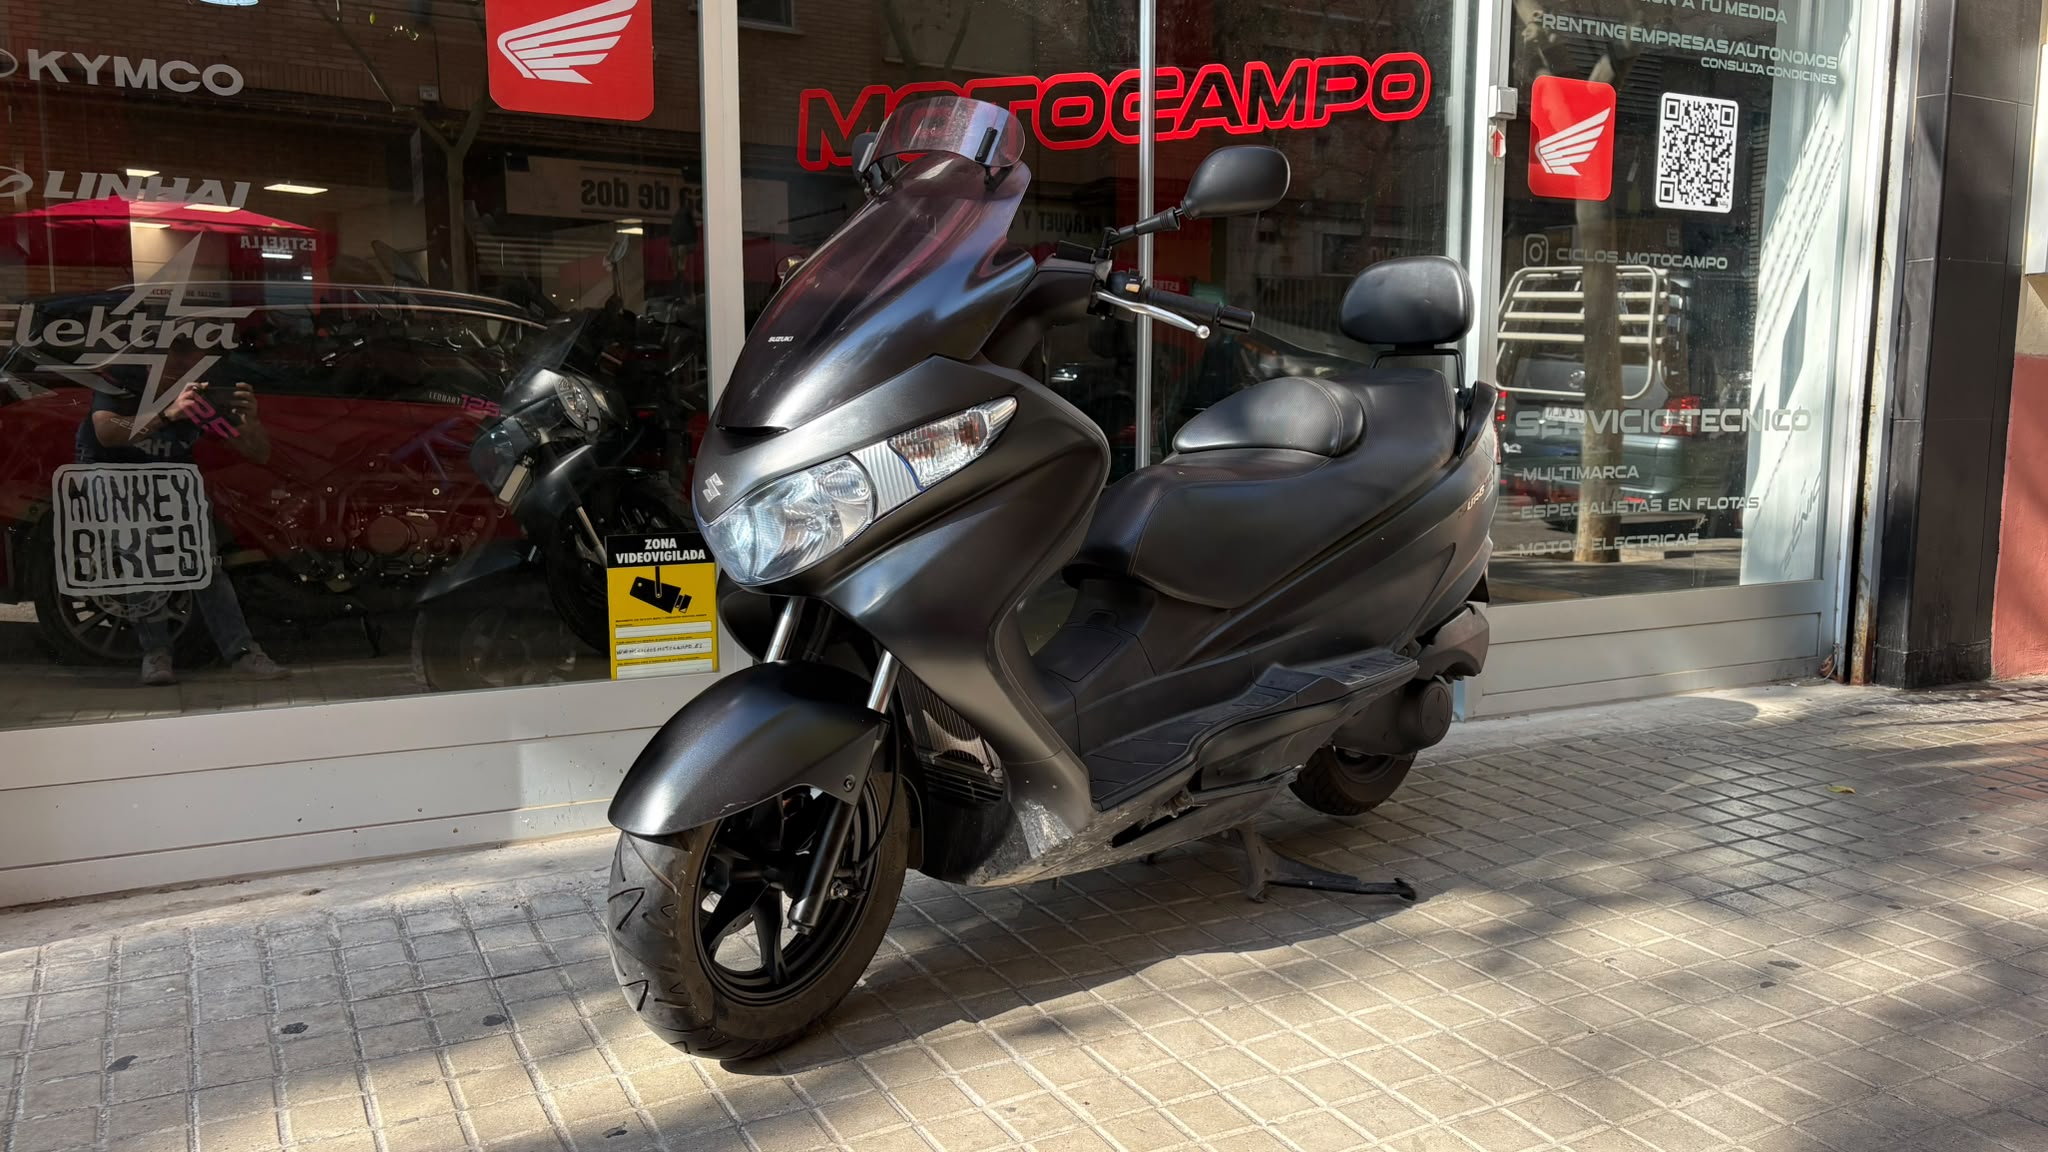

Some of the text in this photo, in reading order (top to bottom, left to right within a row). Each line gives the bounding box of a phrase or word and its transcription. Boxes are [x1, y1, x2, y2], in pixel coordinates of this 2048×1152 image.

[1724, 3, 1788, 25] MEDIDA
[1630, 26, 1838, 70] EMPRESAS/AUTONOMOS
[27, 49, 244, 96] KYMCO
[1700, 56, 1838, 85] CONSULTA CONDICINES
[798, 51, 1431, 171] MOTOCAMPO
[43, 170, 251, 208] LINHAI
[1556, 247, 1729, 270] CICLOS_MOTOCAMPO
[1515, 409, 1673, 438] SERVICIO
[1680, 408, 1811, 433] TECNICO
[1514, 465, 1640, 482] -MULTIMARCA
[68, 474, 190, 524] MONKEY
[1512, 496, 1760, 519] -ESPECALISTAS EN FLOTAS
[72, 524, 199, 582] BIKES
[644, 537, 678, 550] ZONA
[1592, 533, 1700, 550] ELECTRICAS
[615, 549, 706, 564] VIDEOVIGILADA
